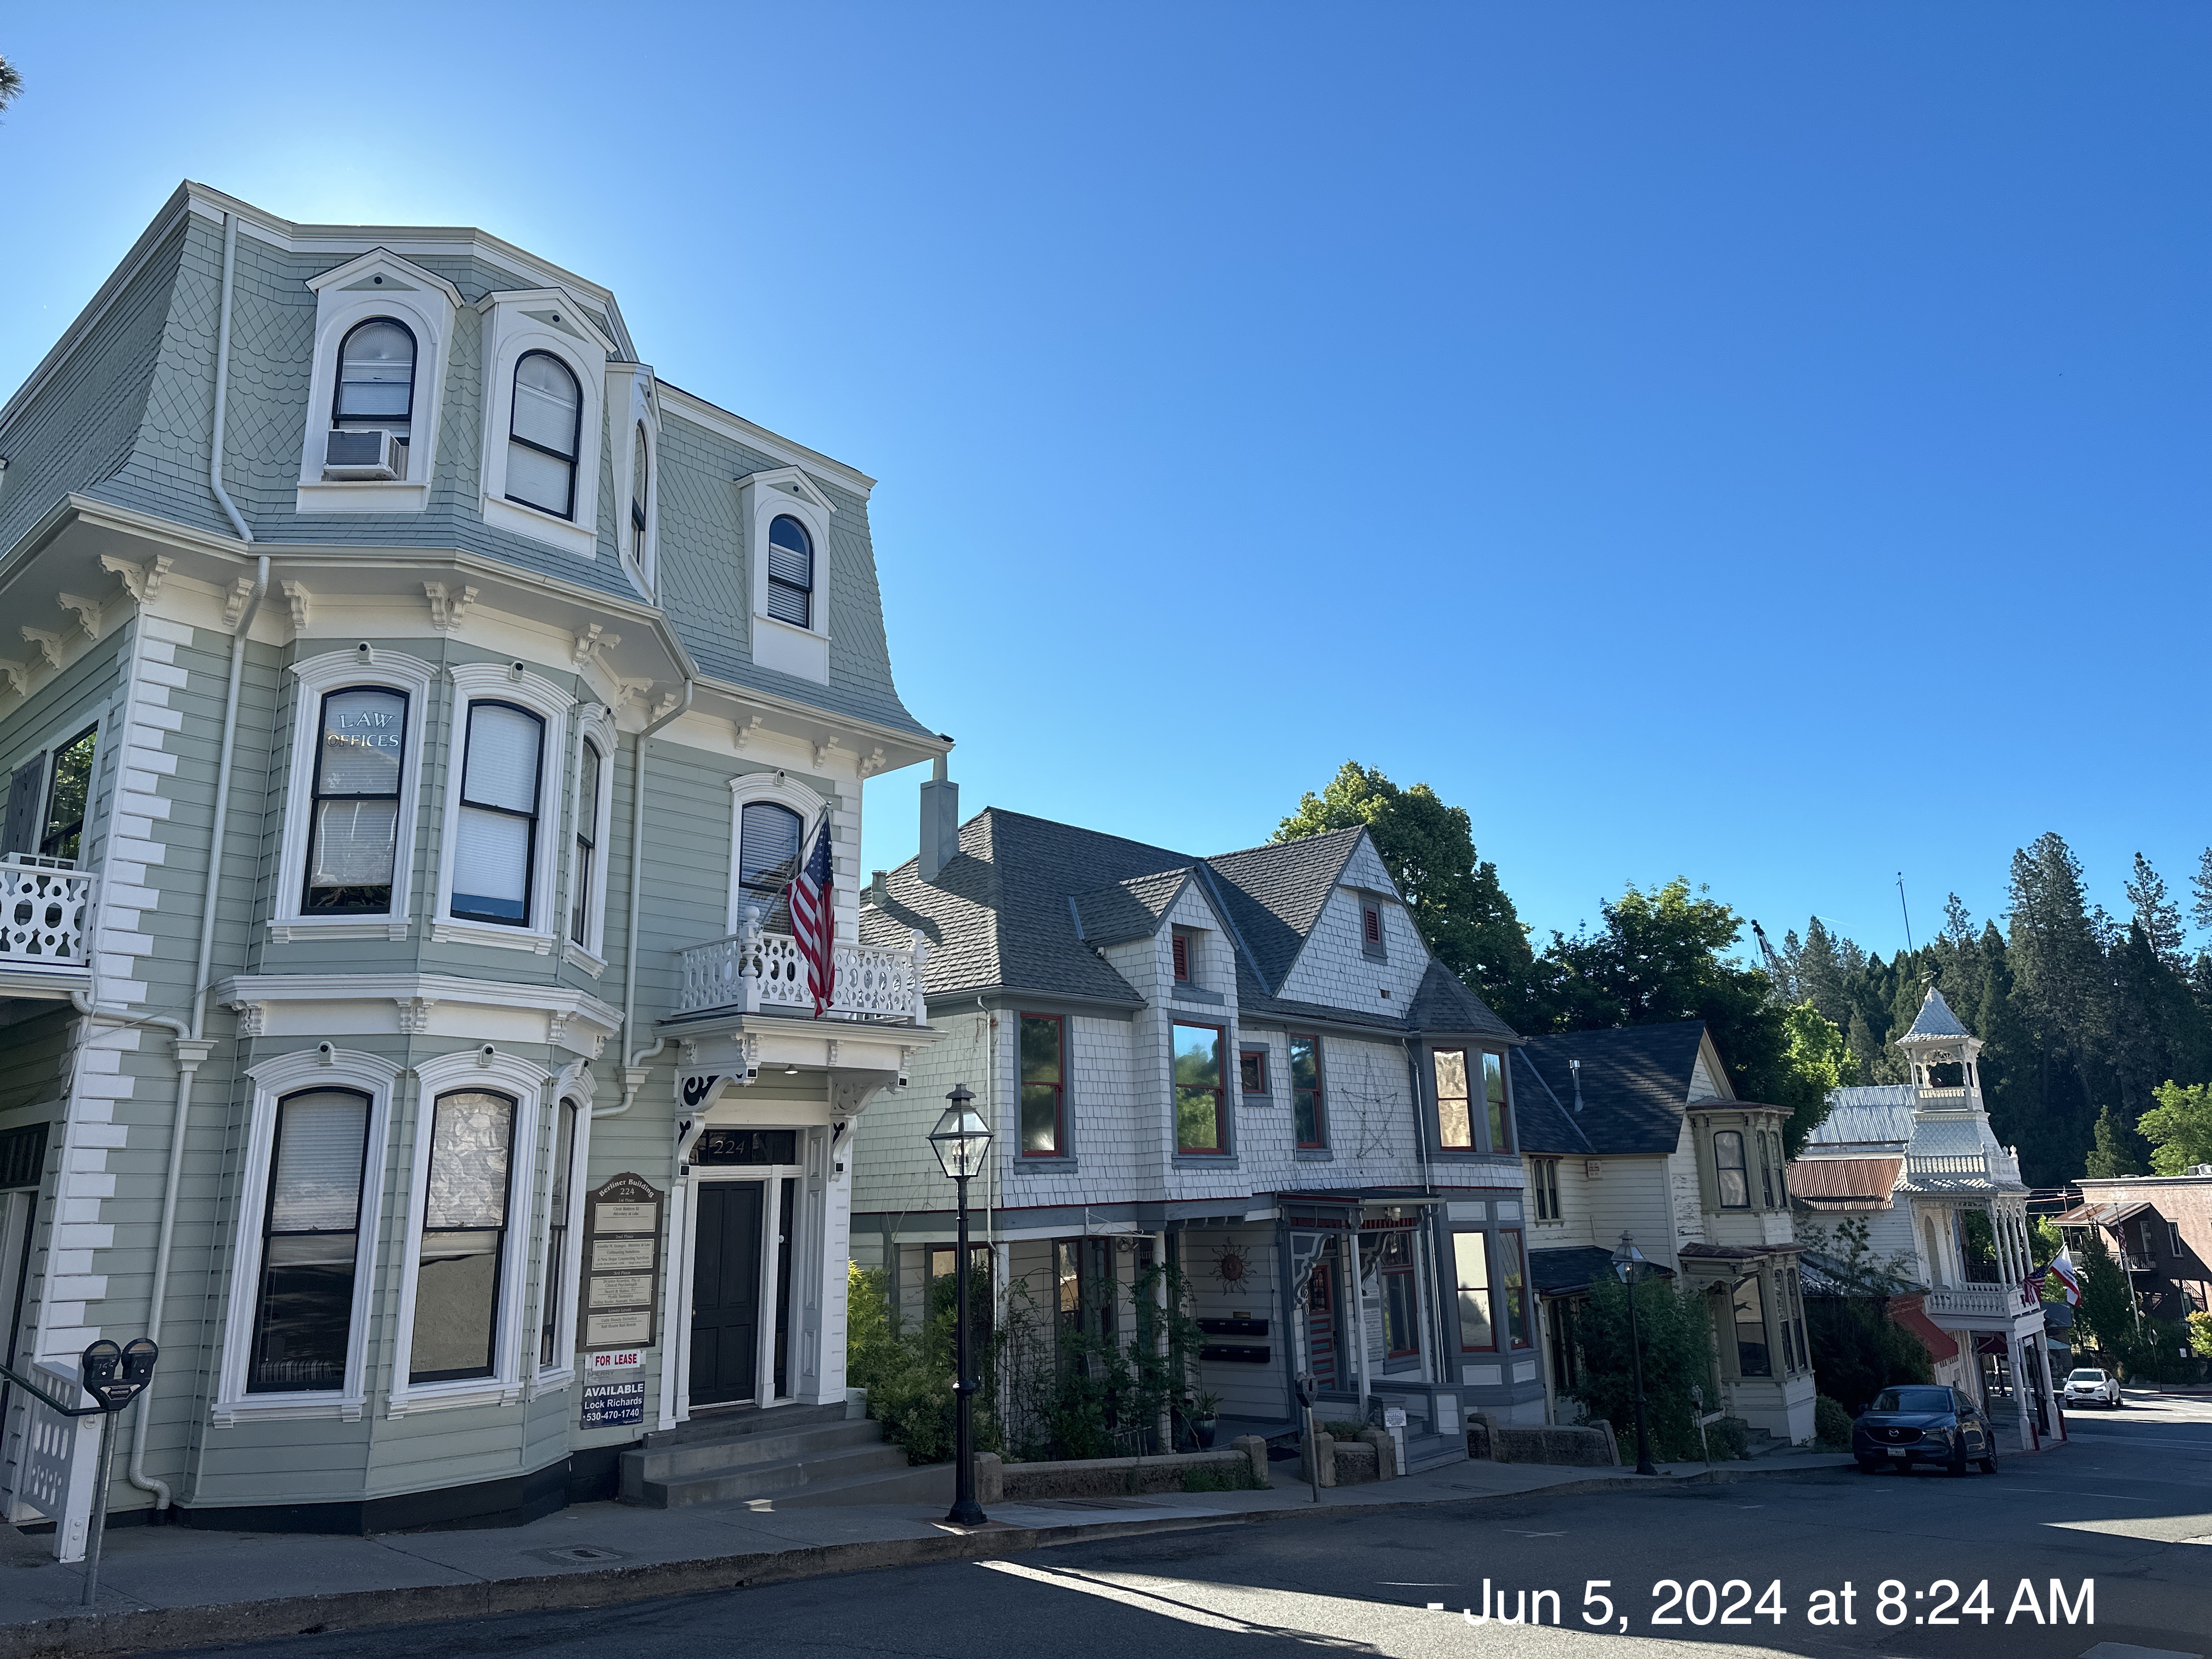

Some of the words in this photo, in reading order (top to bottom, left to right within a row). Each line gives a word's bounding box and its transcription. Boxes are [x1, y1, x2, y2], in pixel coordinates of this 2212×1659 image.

[339, 711, 395, 729] LAW
[327, 734, 399, 747] OFFICES
[714, 1140, 746, 1154] 224
[599, 1180, 626, 1197] Berliner
[629, 1179, 654, 1198] Building
[596, 1355, 611, 1367] FOR
[614, 1353, 637, 1365] LEASE
[584, 1384, 644, 1397] AVAILABLE
[585, 1400, 605, 1409] Lock
[607, 1397, 642, 1407] Richards
[586, 1408, 639, 1421] 530-470-1740
